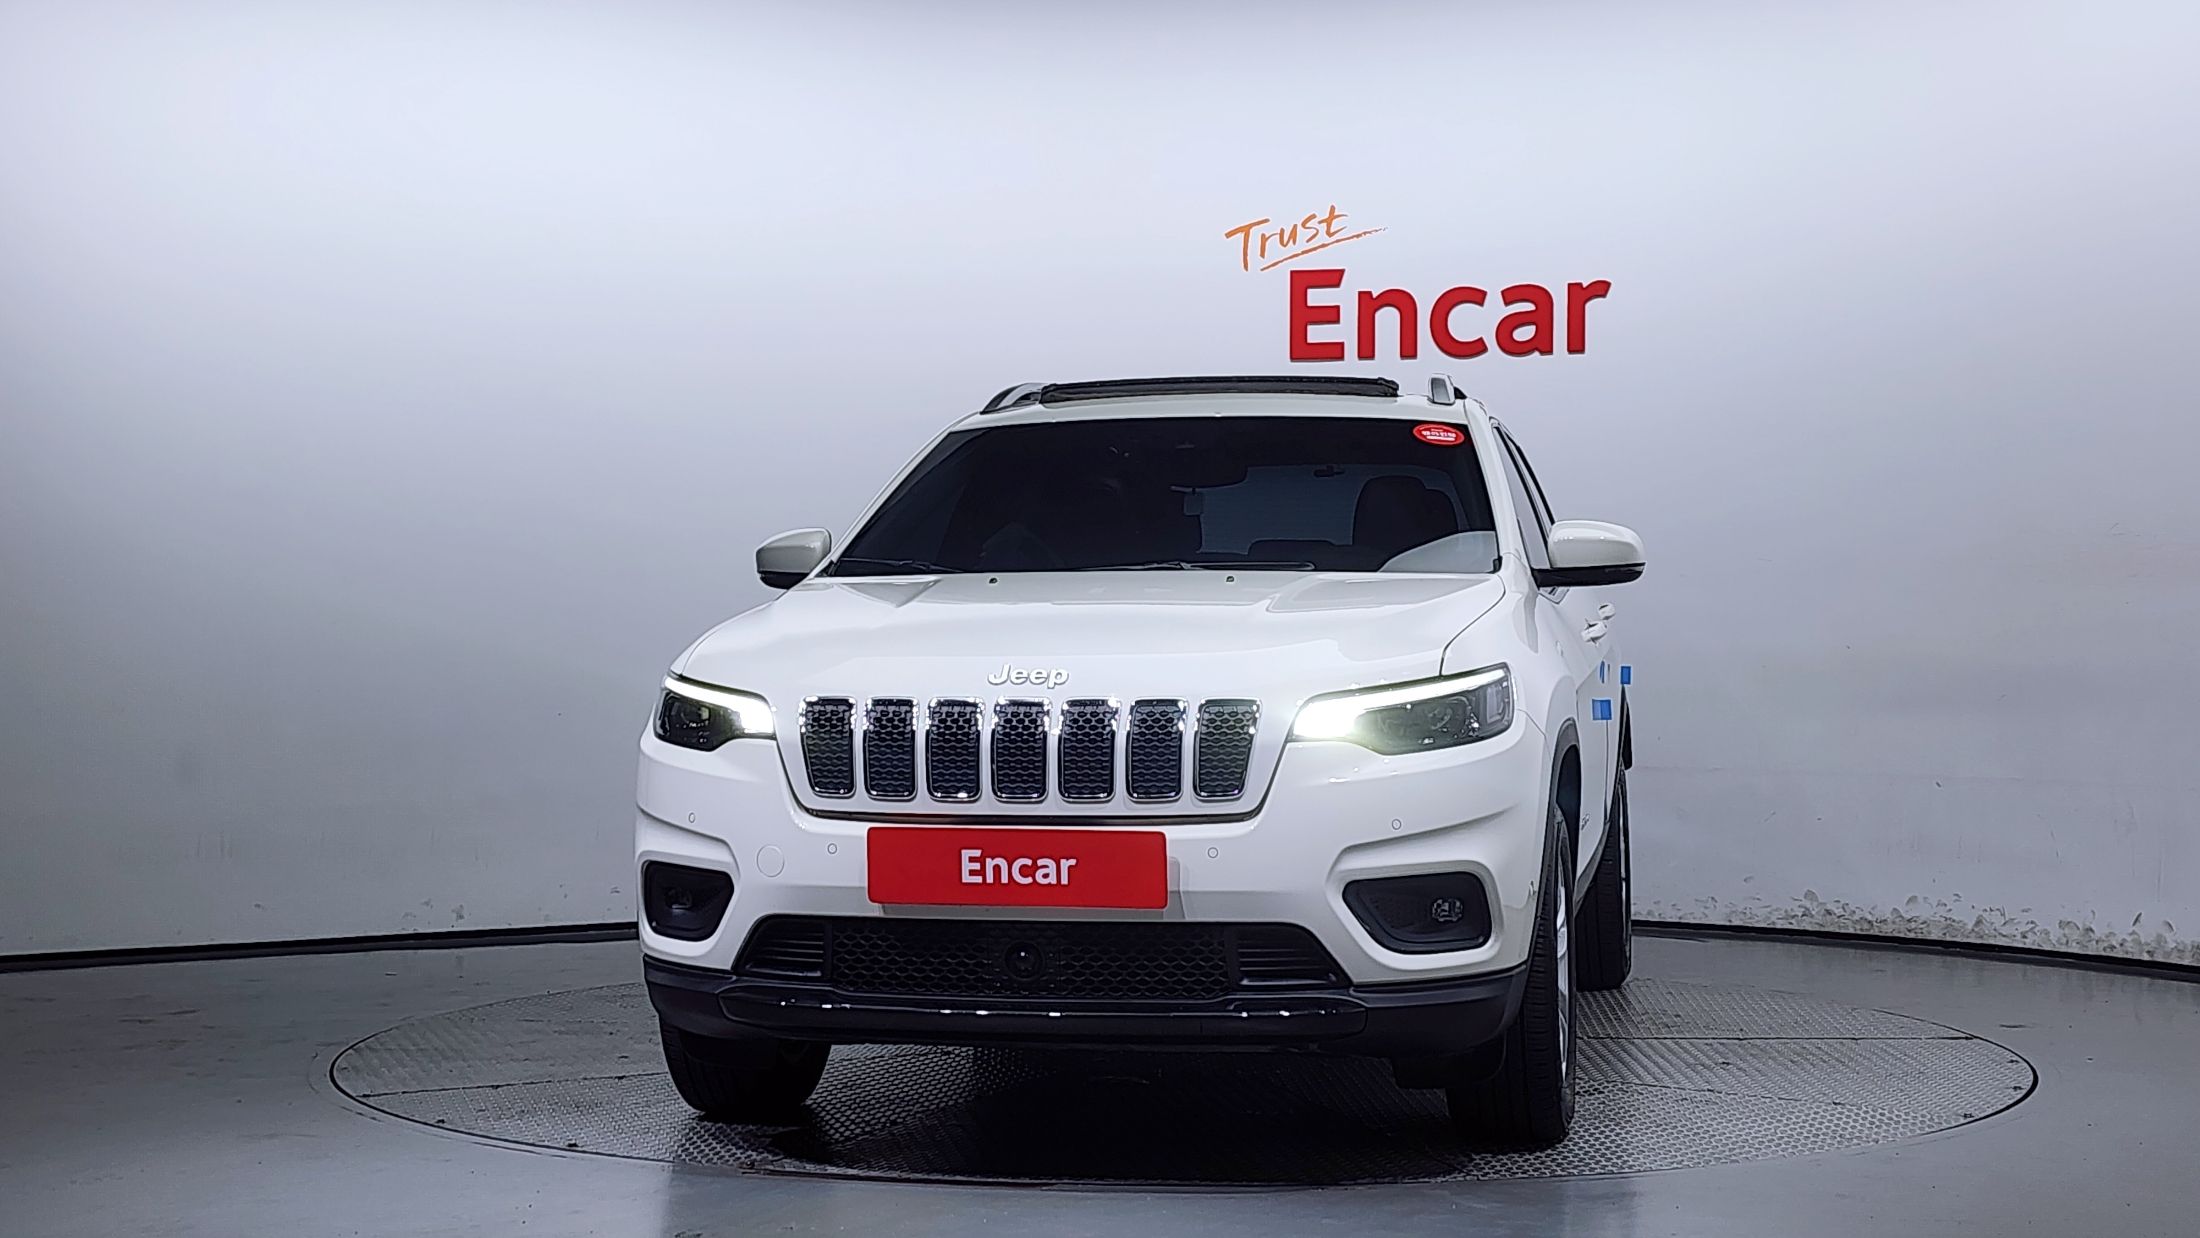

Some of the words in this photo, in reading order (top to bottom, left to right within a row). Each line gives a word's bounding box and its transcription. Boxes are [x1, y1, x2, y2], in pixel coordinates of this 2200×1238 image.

[1224, 204, 1349, 272] Trust
[1289, 268, 1612, 362] Encar
[987, 663, 1070, 690] Jeep
[960, 849, 1077, 886] Encar
